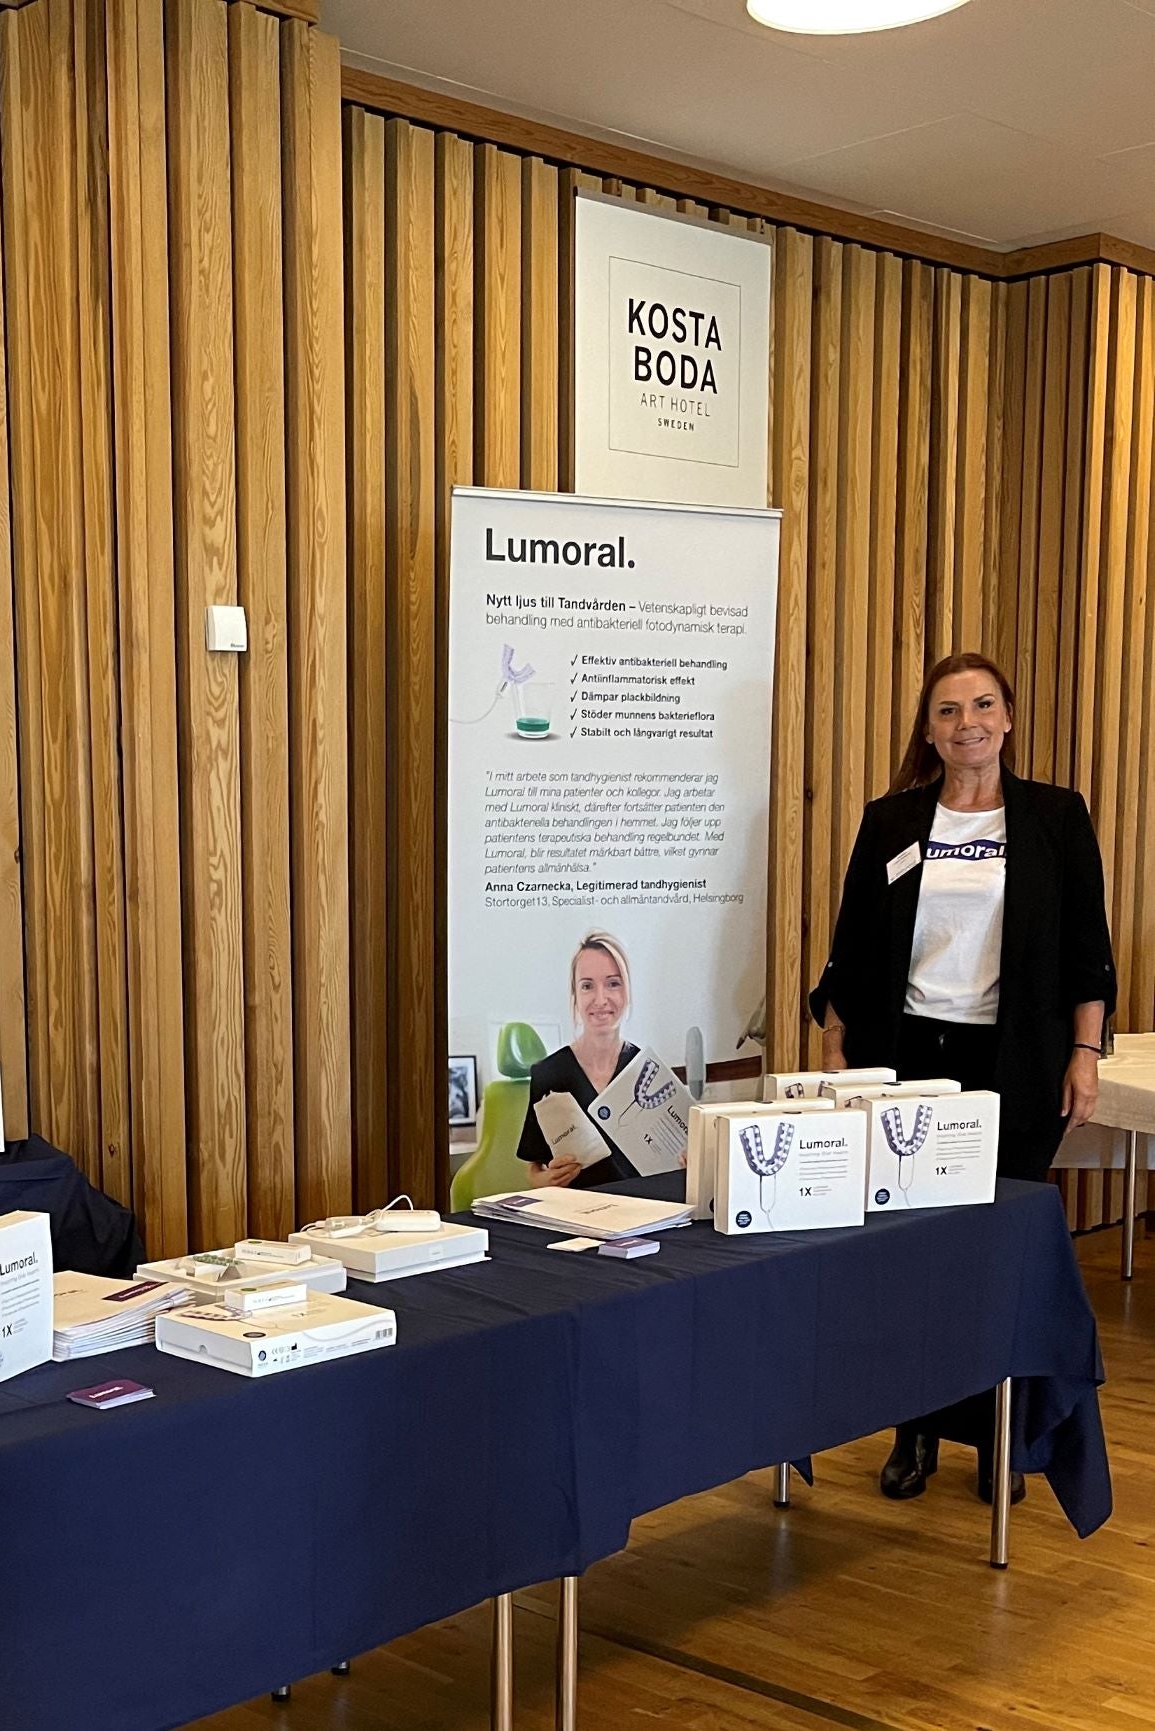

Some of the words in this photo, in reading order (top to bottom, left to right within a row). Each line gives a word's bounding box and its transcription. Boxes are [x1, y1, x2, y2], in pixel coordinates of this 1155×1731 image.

[628, 298, 722, 351] KOSTA
[634, 346, 718, 394] BODA
[640, 393, 665, 409] ART
[671, 397, 710, 417] HOTEL
[657, 417, 695, 431] SWEDEN
[486, 528, 636, 569] Lumoral.
[486, 594, 512, 608] Nytt
[515, 595, 536, 609] ljus
[540, 596, 554, 607] till
[557, 597, 625, 611] Tandvården
[638, 602, 706, 616] Vetenskapligt
[709, 606, 748, 616] bevisad
[486, 612, 547, 629] behandling
[550, 616, 573, 627] med
[576, 617, 642, 629] antibakteriell
[645, 619, 714, 633] fotodynamisk
[581, 655, 616, 664] Effektiv
[619, 657, 676, 666] antibakteriell
[679, 659, 727, 670] behandling
[581, 673, 667, 684] Antiinflammatorisk
[669, 676, 694, 685] effekt
[581, 692, 618, 702] Dämpar
[621, 693, 680, 704] plackbildning
[581, 709, 612, 718] Stöder
[658, 711, 714, 720] bakterieflora
[580, 727, 611, 736] Stabilt
[613, 728, 631, 736] och
[633, 728, 676, 739] långvarigt
[679, 729, 713, 737] resultat
[494, 772, 513, 781] mitt
[516, 772, 546, 781] arbete
[548, 773, 568, 781] som
[570, 772, 632, 784] tandhygienist
[633, 772, 703, 782] rekommenderar
[704, 774, 718, 784] jag
[926, 845, 1005, 858] umoral
[484, 882, 513, 891] Anna
[516, 881, 573, 891] Czarnecka,
[576, 880, 638, 892] Legitimerad
[640, 879, 706, 890] tandhygienist
[551, 895, 598, 906] och
[600, 895, 619, 905] och
[620, 893, 691, 905] allmäntandvård,
[693, 893, 743, 904] Helsingborg
[937, 1119, 981, 1130] Lumoral.
[799, 1137, 848, 1149] Lumoral.
[935, 1166, 947, 1175] 1X
[799, 1186, 812, 1197] 1X
[0, 1252, 38, 1276] Lumoral.
[2, 1323, 13, 1338] 1X
